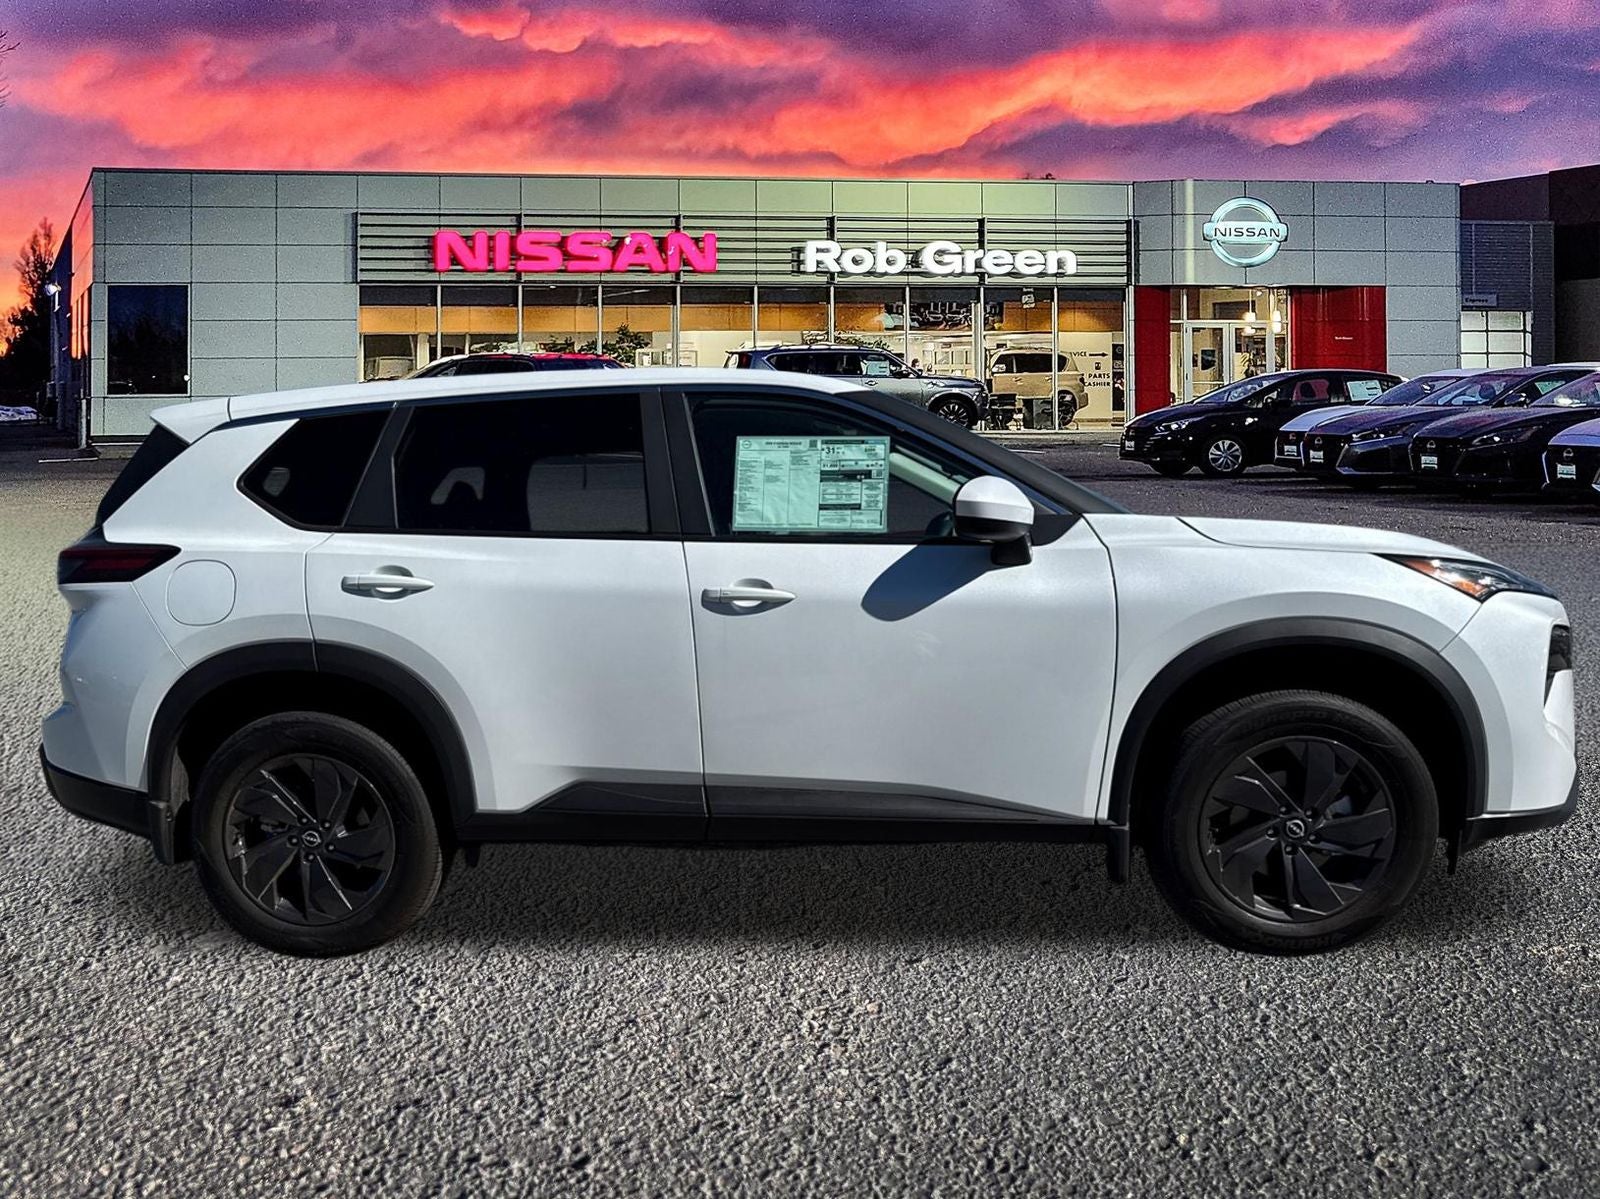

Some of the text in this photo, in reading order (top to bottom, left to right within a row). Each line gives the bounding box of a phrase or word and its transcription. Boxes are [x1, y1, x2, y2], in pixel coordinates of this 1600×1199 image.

[1214, 227, 1280, 238] NISSAN
[433, 230, 718, 273] NISSAN
[805, 240, 1078, 275] Rob Green
